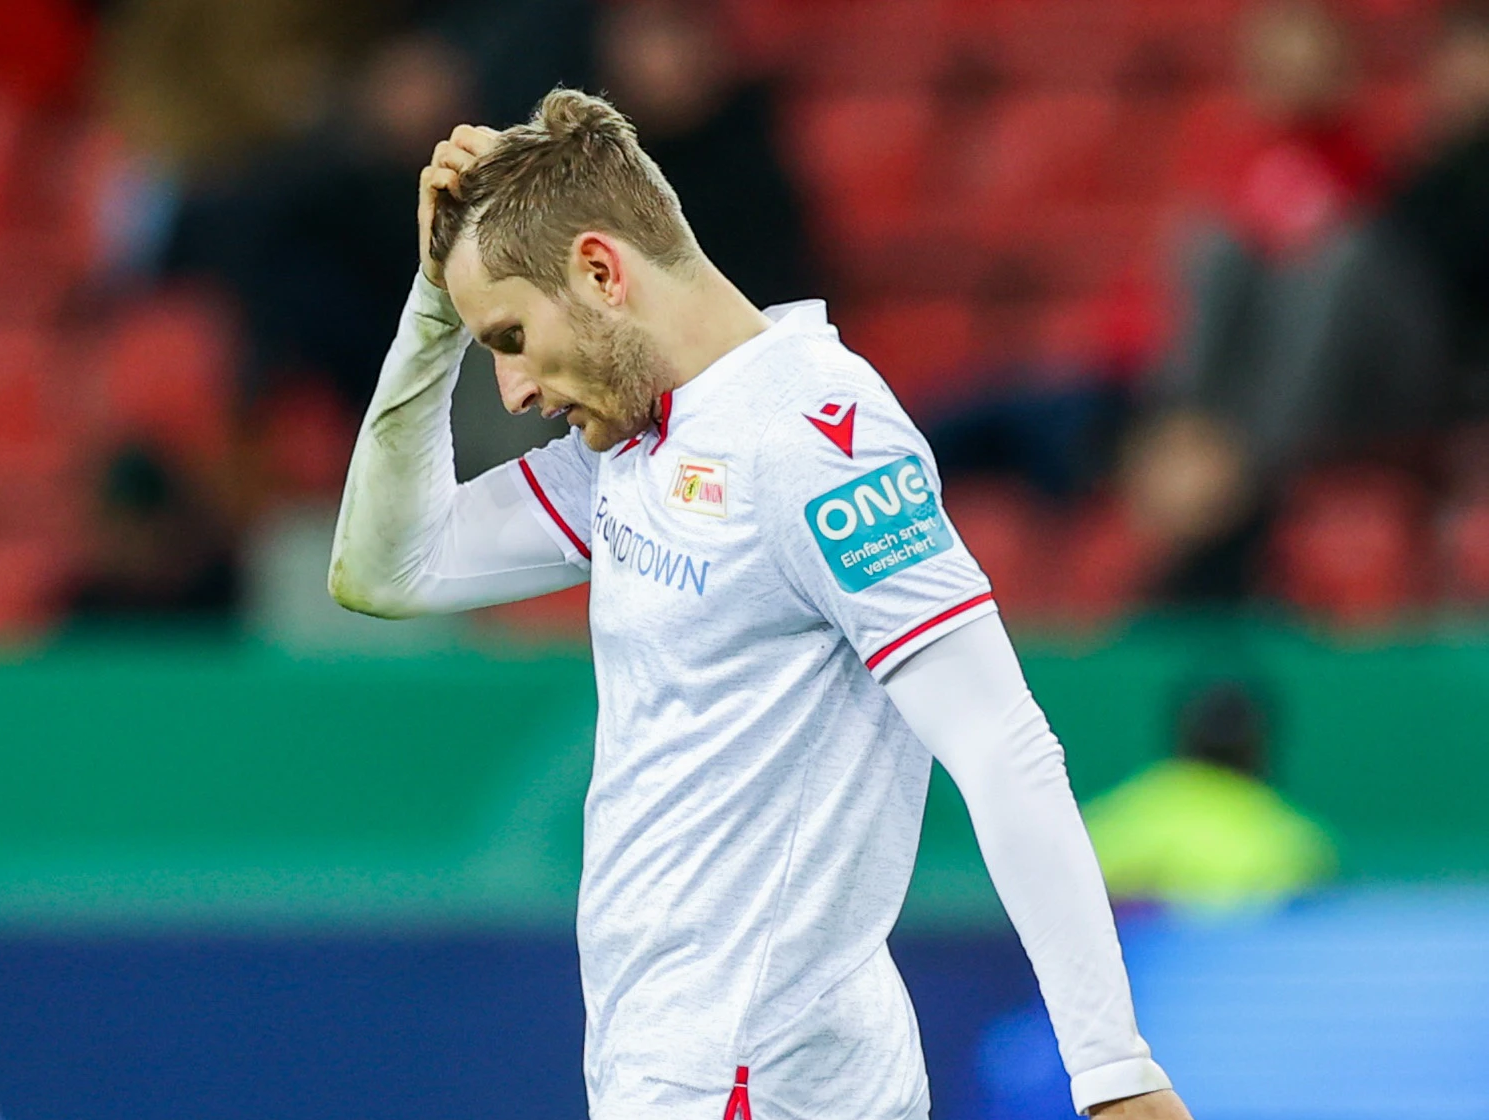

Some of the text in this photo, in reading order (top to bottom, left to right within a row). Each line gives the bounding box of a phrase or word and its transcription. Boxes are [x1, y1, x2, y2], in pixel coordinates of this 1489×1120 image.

[815, 463, 929, 541] ONE
[840, 516, 937, 569] Einfach smart
[862, 535, 937, 576] versichert
